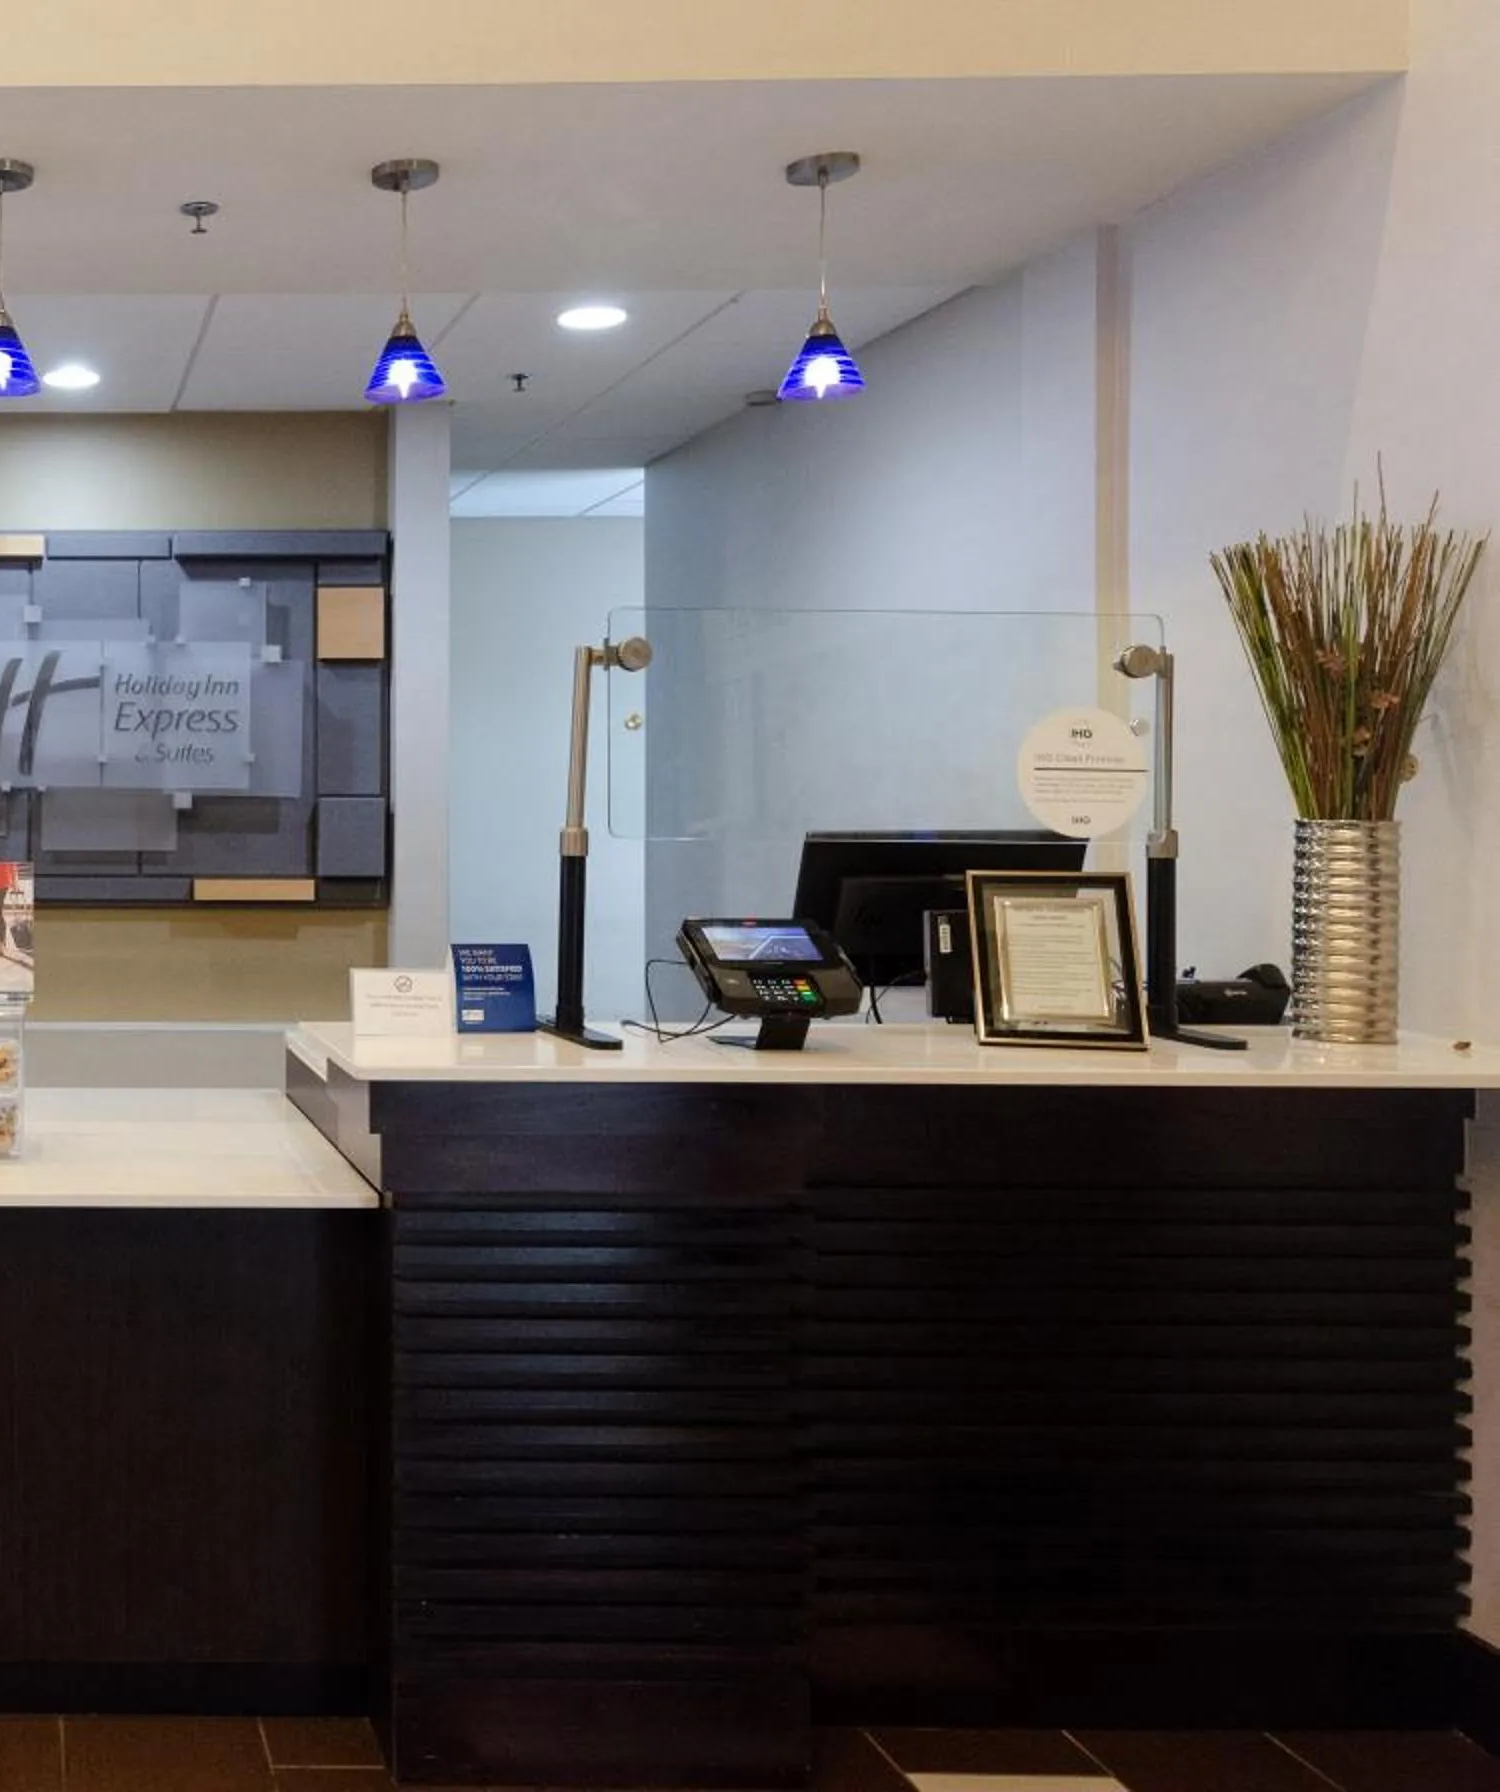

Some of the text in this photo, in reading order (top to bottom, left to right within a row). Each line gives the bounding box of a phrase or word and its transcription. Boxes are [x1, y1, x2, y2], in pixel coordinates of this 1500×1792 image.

[115, 673, 240, 701] Holiday Inn
[114, 701, 240, 741] Express
[153, 743, 215, 765] Suites
